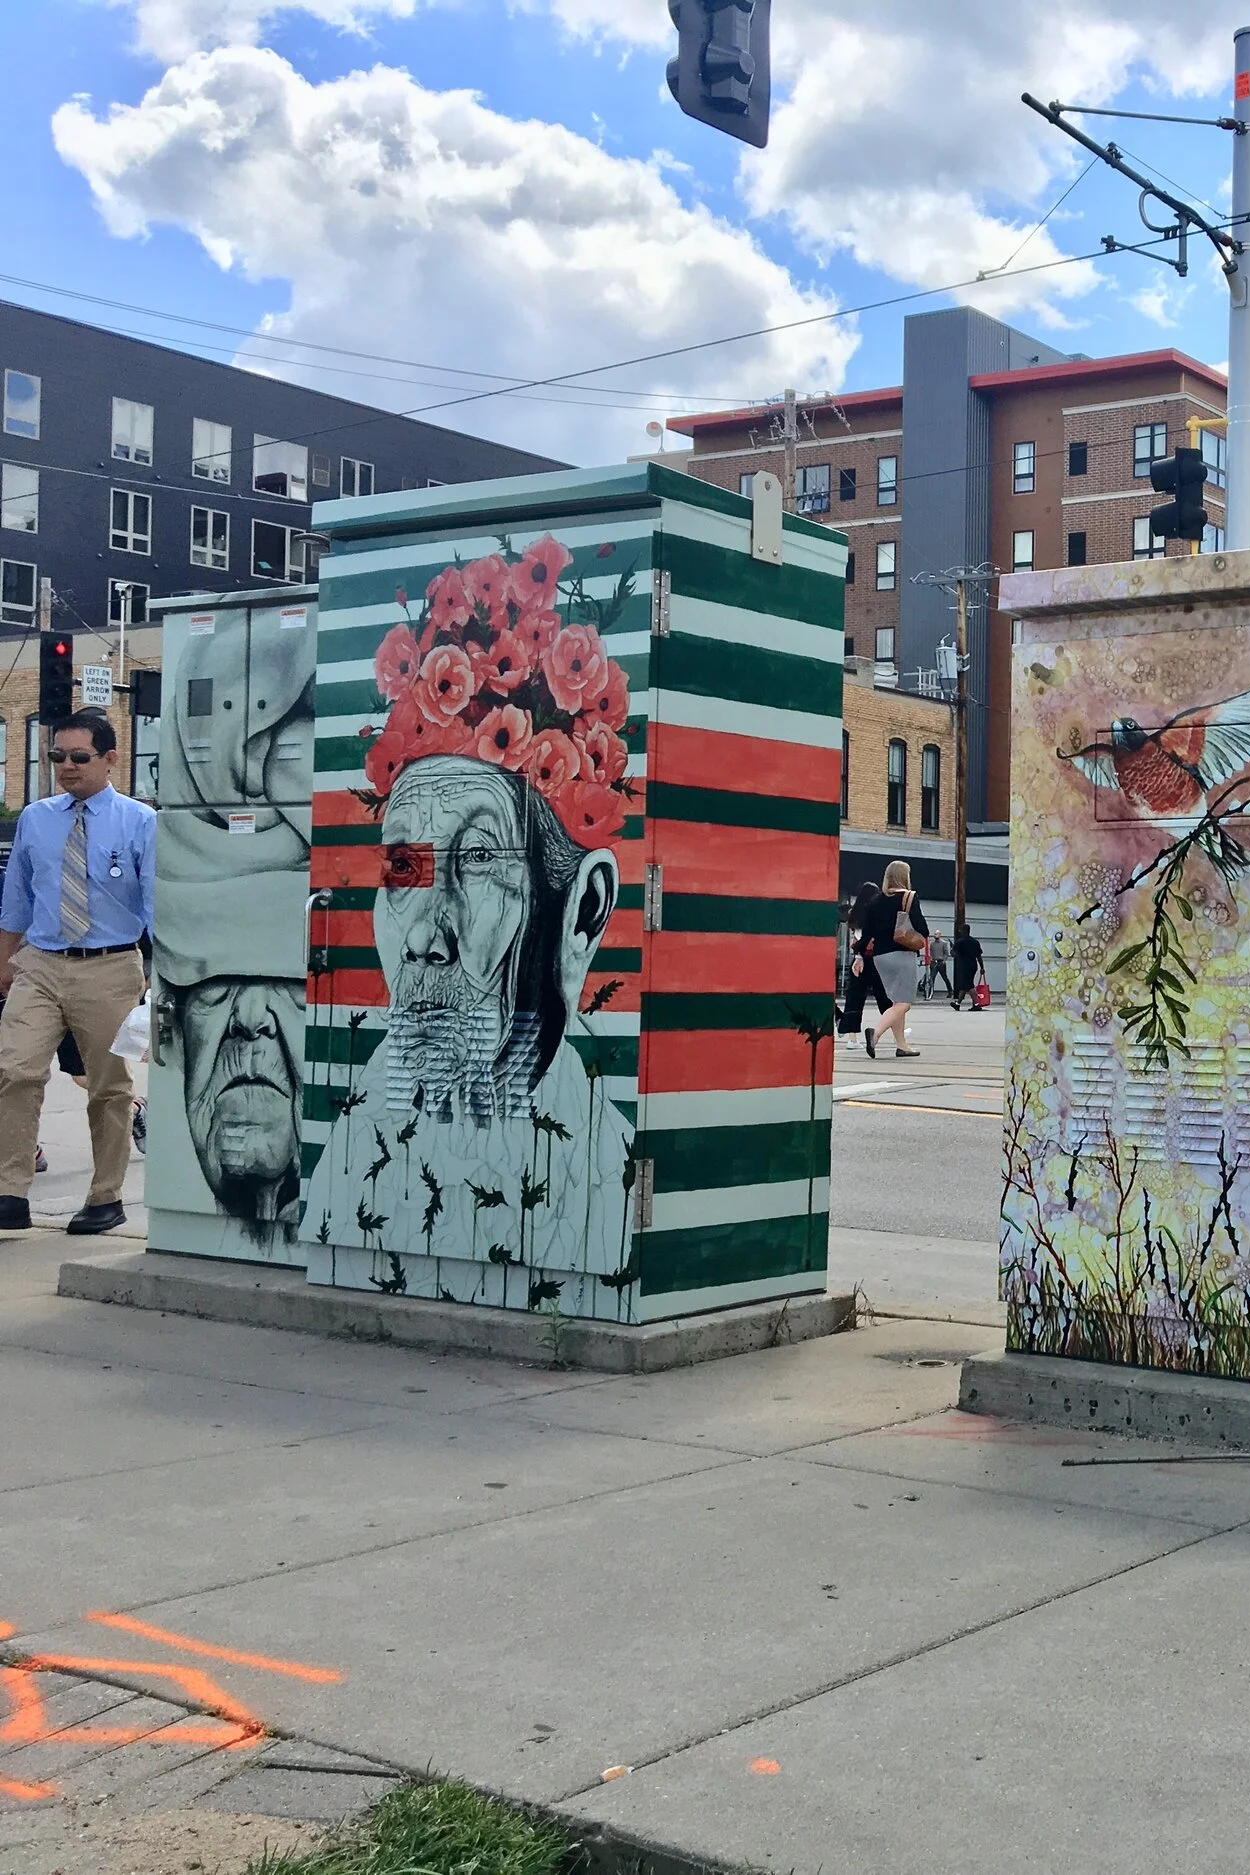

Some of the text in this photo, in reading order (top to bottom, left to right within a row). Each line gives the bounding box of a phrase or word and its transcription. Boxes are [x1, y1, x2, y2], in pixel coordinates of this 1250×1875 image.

[86, 668, 100, 676] LEFT
[87, 677, 109, 685] GREEN
[86, 686, 110, 694] ARROW
[88, 695, 107, 703] ONLY
